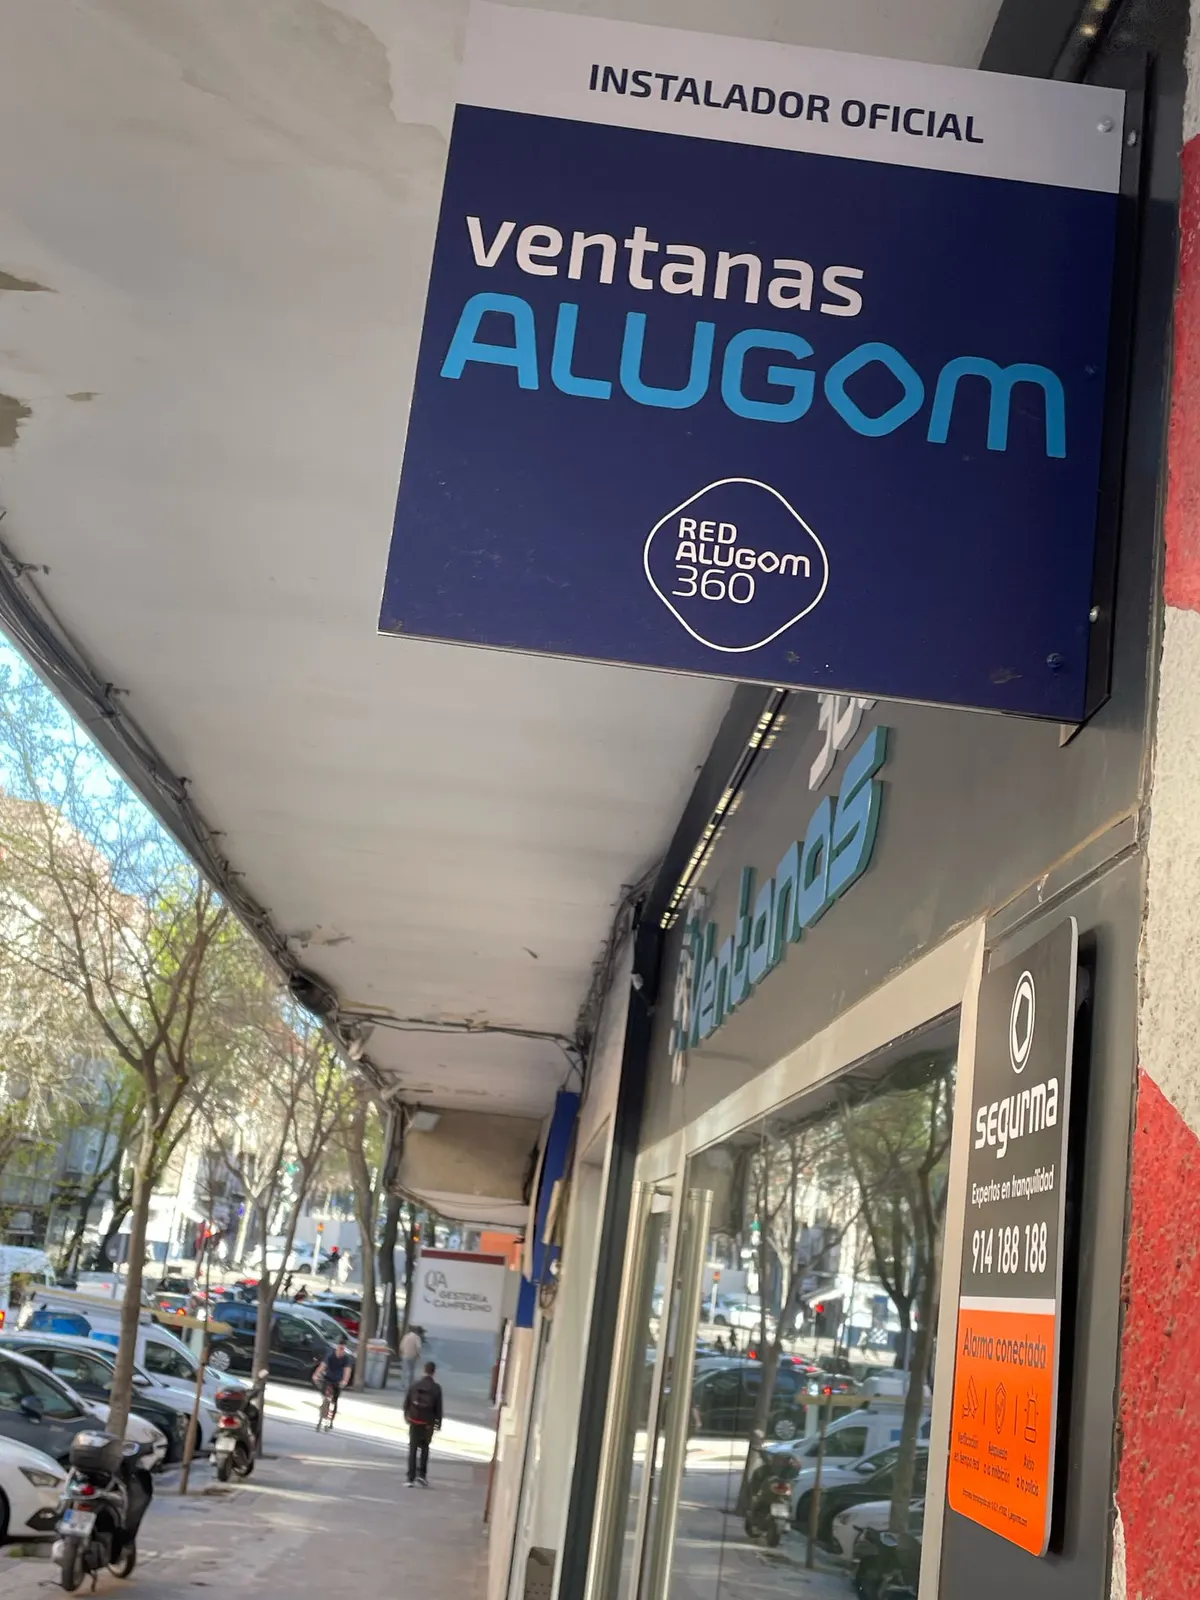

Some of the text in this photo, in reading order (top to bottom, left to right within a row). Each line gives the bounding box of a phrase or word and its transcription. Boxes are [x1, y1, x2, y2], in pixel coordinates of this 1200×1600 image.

[589, 63, 985, 144] INSTALADOR OFICIAL
[465, 215, 865, 318] ventanas
[678, 517, 737, 545] RED
[671, 564, 756, 604] 360
[975, 1077, 1059, 1159] segurma
[971, 1164, 1055, 1209] Expertos en tranquilidad
[972, 1221, 1048, 1274] 914 188 188
[963, 1328, 1047, 1369] Alarma conectada
